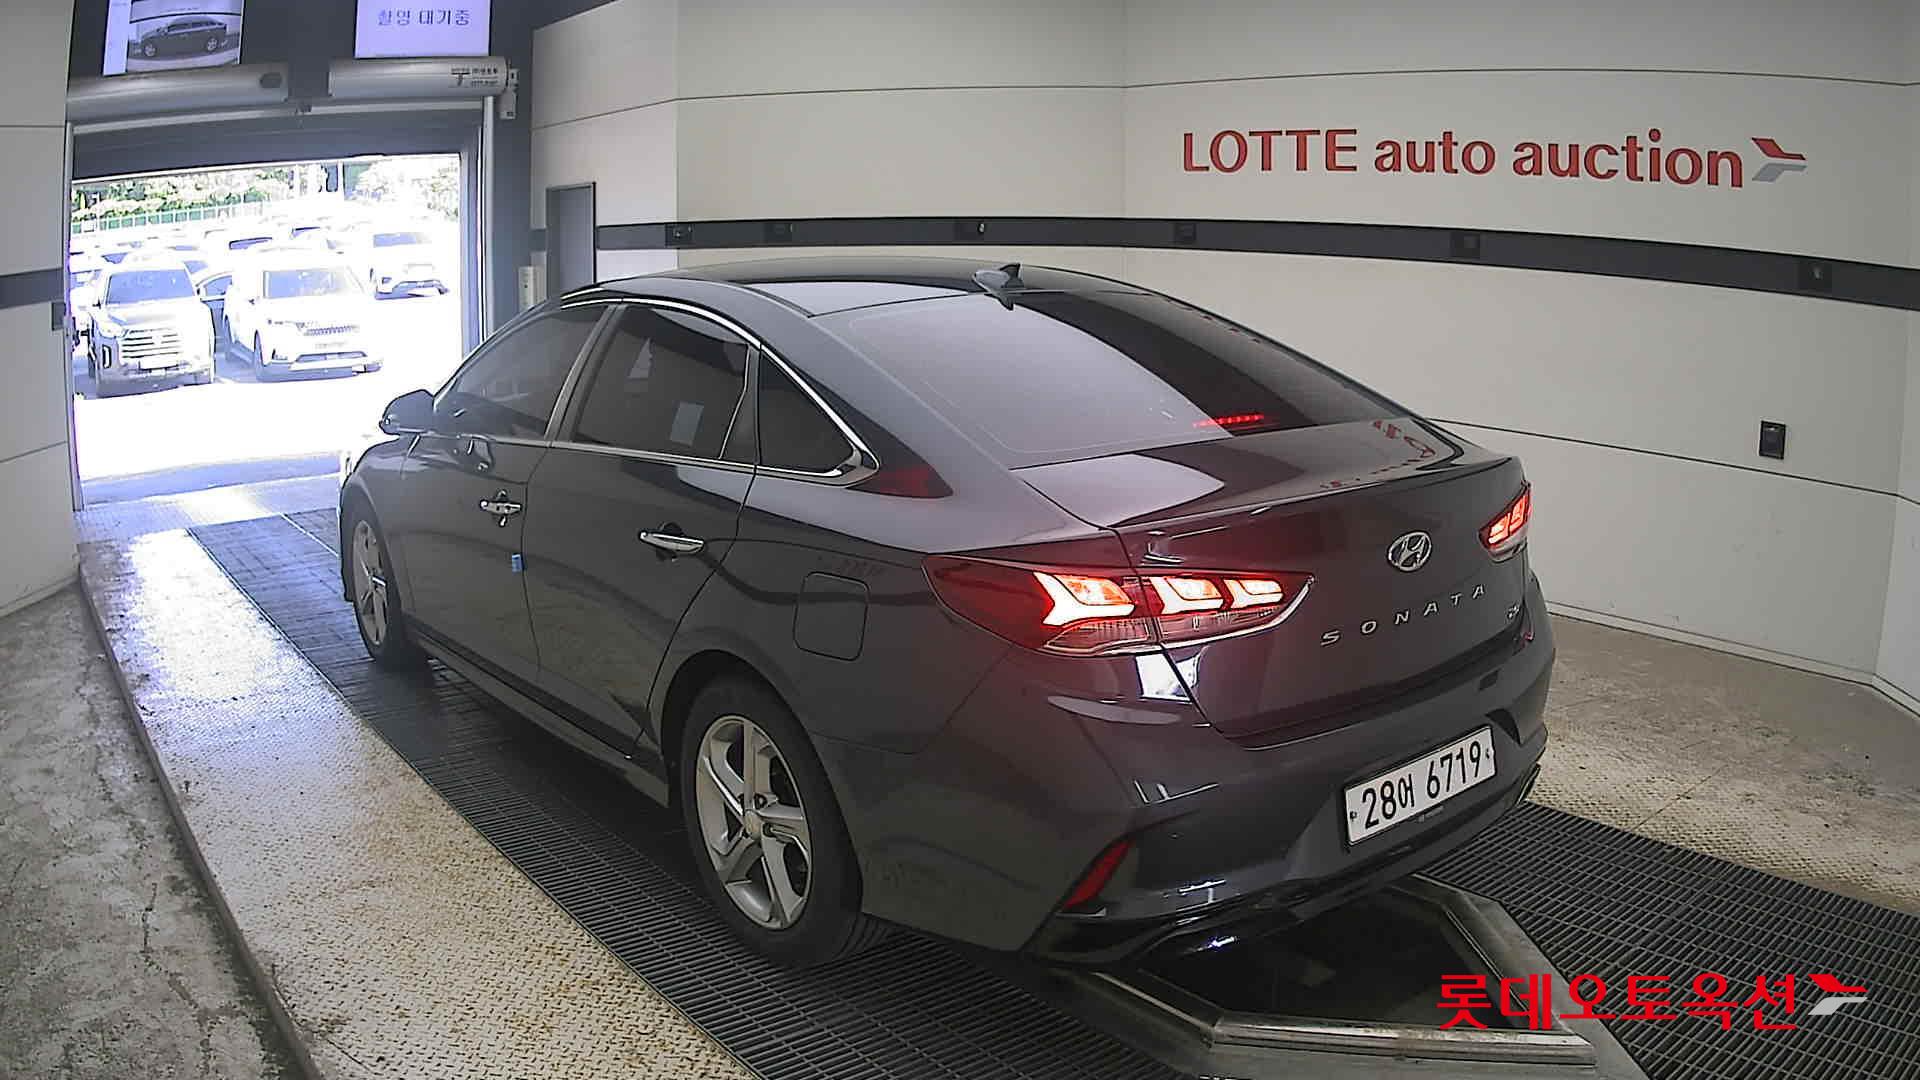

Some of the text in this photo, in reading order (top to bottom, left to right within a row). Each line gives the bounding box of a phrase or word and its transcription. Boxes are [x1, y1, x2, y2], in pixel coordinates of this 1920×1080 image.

[418, 8, 470, 26] 대기중
[1183, 128, 1744, 189] LOTTE auto auction
[1319, 583, 1486, 646] SONATA
[1361, 740, 1482, 830] 28어 6719
